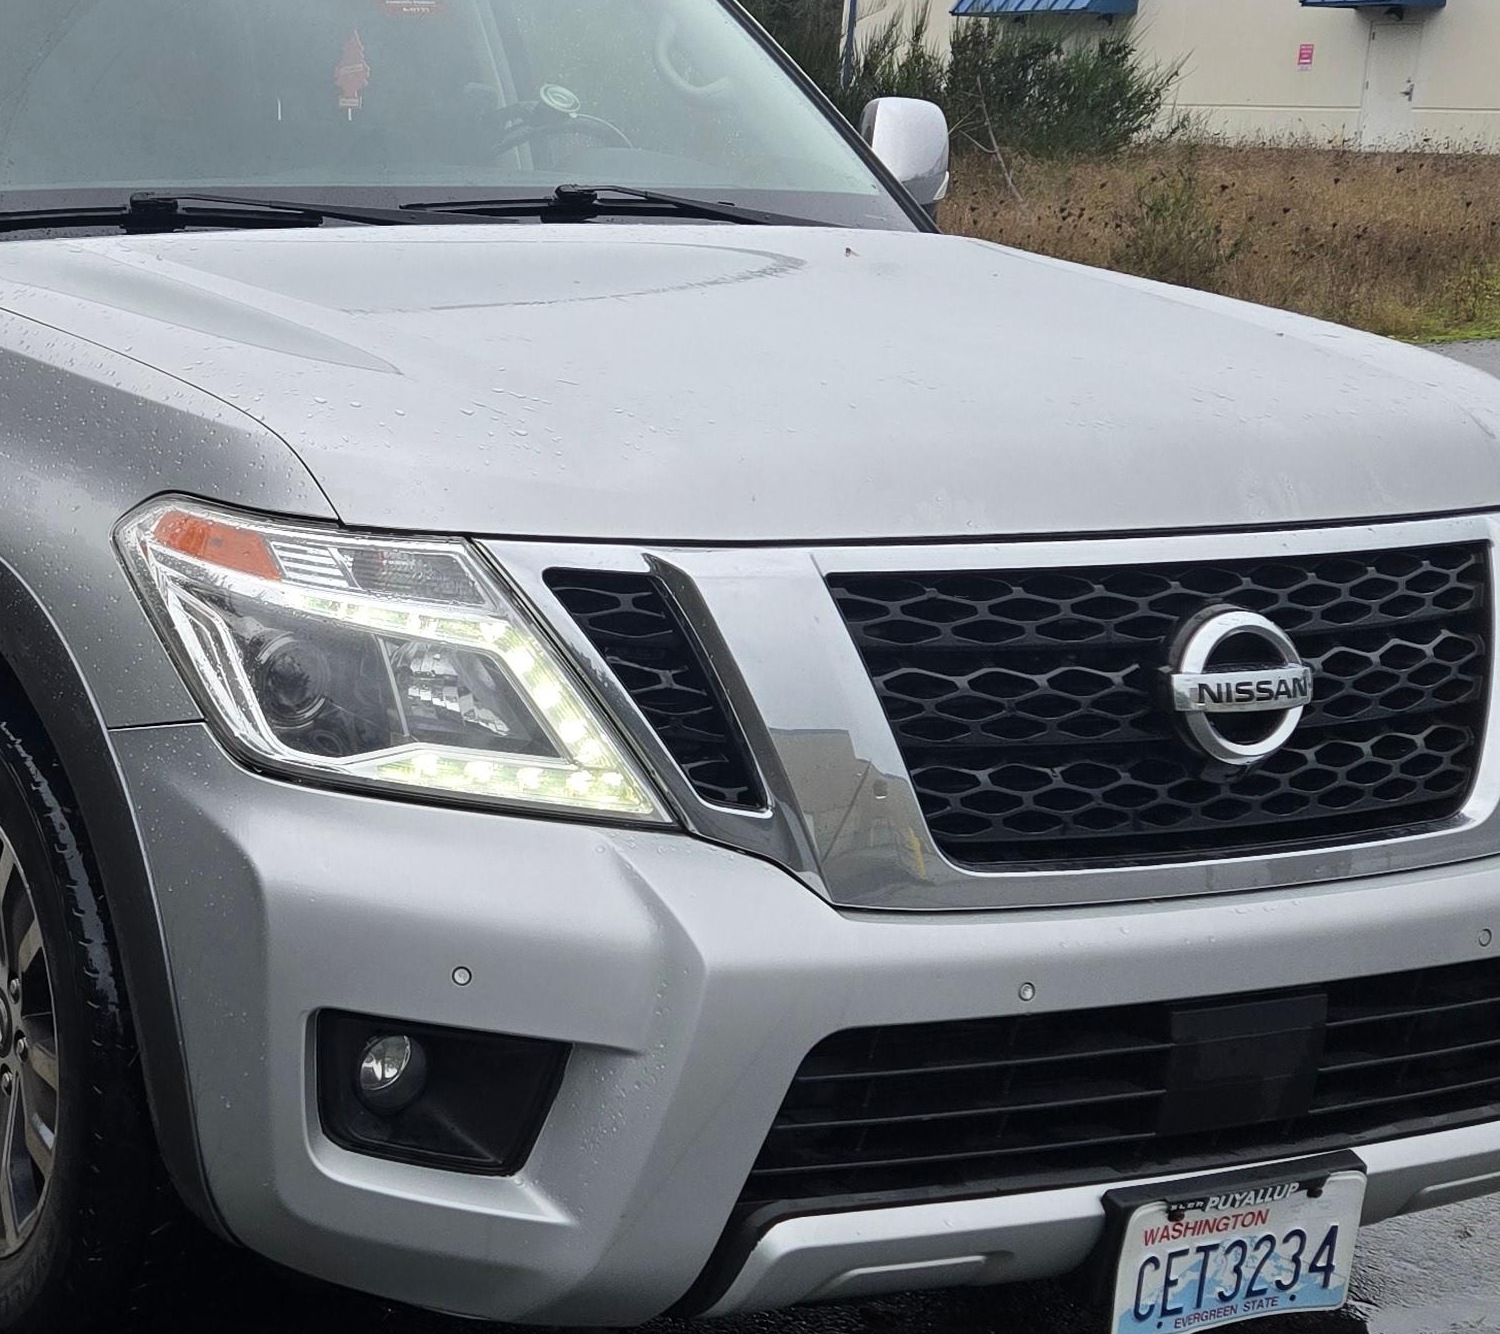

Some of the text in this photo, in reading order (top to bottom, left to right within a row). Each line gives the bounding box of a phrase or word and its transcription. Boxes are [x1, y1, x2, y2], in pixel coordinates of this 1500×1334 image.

[1197, 676, 1308, 704] NISSAN
[1204, 1182, 1300, 1212] PUYALLUP
[1143, 1208, 1270, 1246] WASHINGTON
[1133, 1224, 1340, 1322] CET3234
[1174, 1296, 1279, 1329] EVERGREEN STATE
